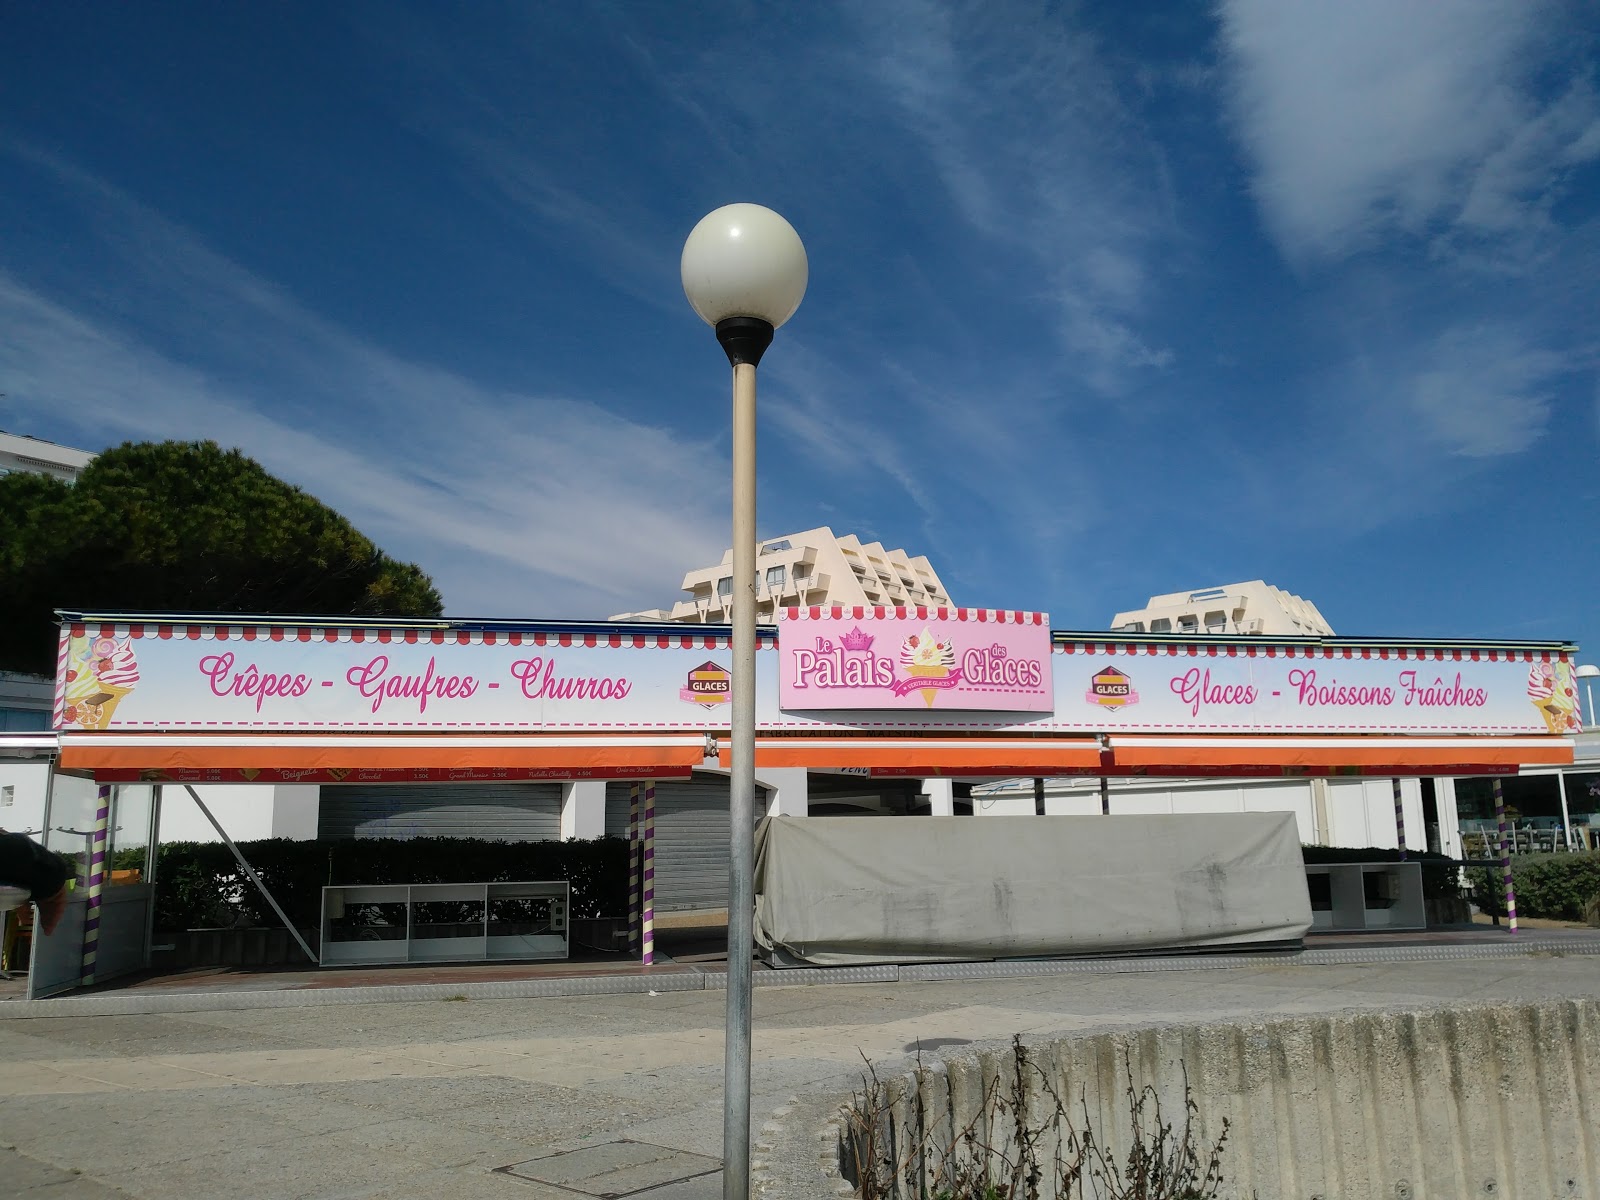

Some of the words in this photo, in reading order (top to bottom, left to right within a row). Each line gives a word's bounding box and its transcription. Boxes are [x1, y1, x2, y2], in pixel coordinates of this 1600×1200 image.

[815, 637, 833, 655] Le
[991, 643, 1007, 658] des
[793, 647, 896, 688] Palais
[963, 648, 1042, 687] Glaces
[200, 652, 311, 713] Crêpes
[346, 656, 479, 714] Gaufres
[511, 657, 633, 700] Churros
[692, 682, 728, 691] GLACES
[1096, 685, 1128, 694] GLACES
[1170, 668, 1258, 717] Glaces
[1288, 669, 1395, 706] Boissons
[1399, 670, 1488, 707] Fraîches
